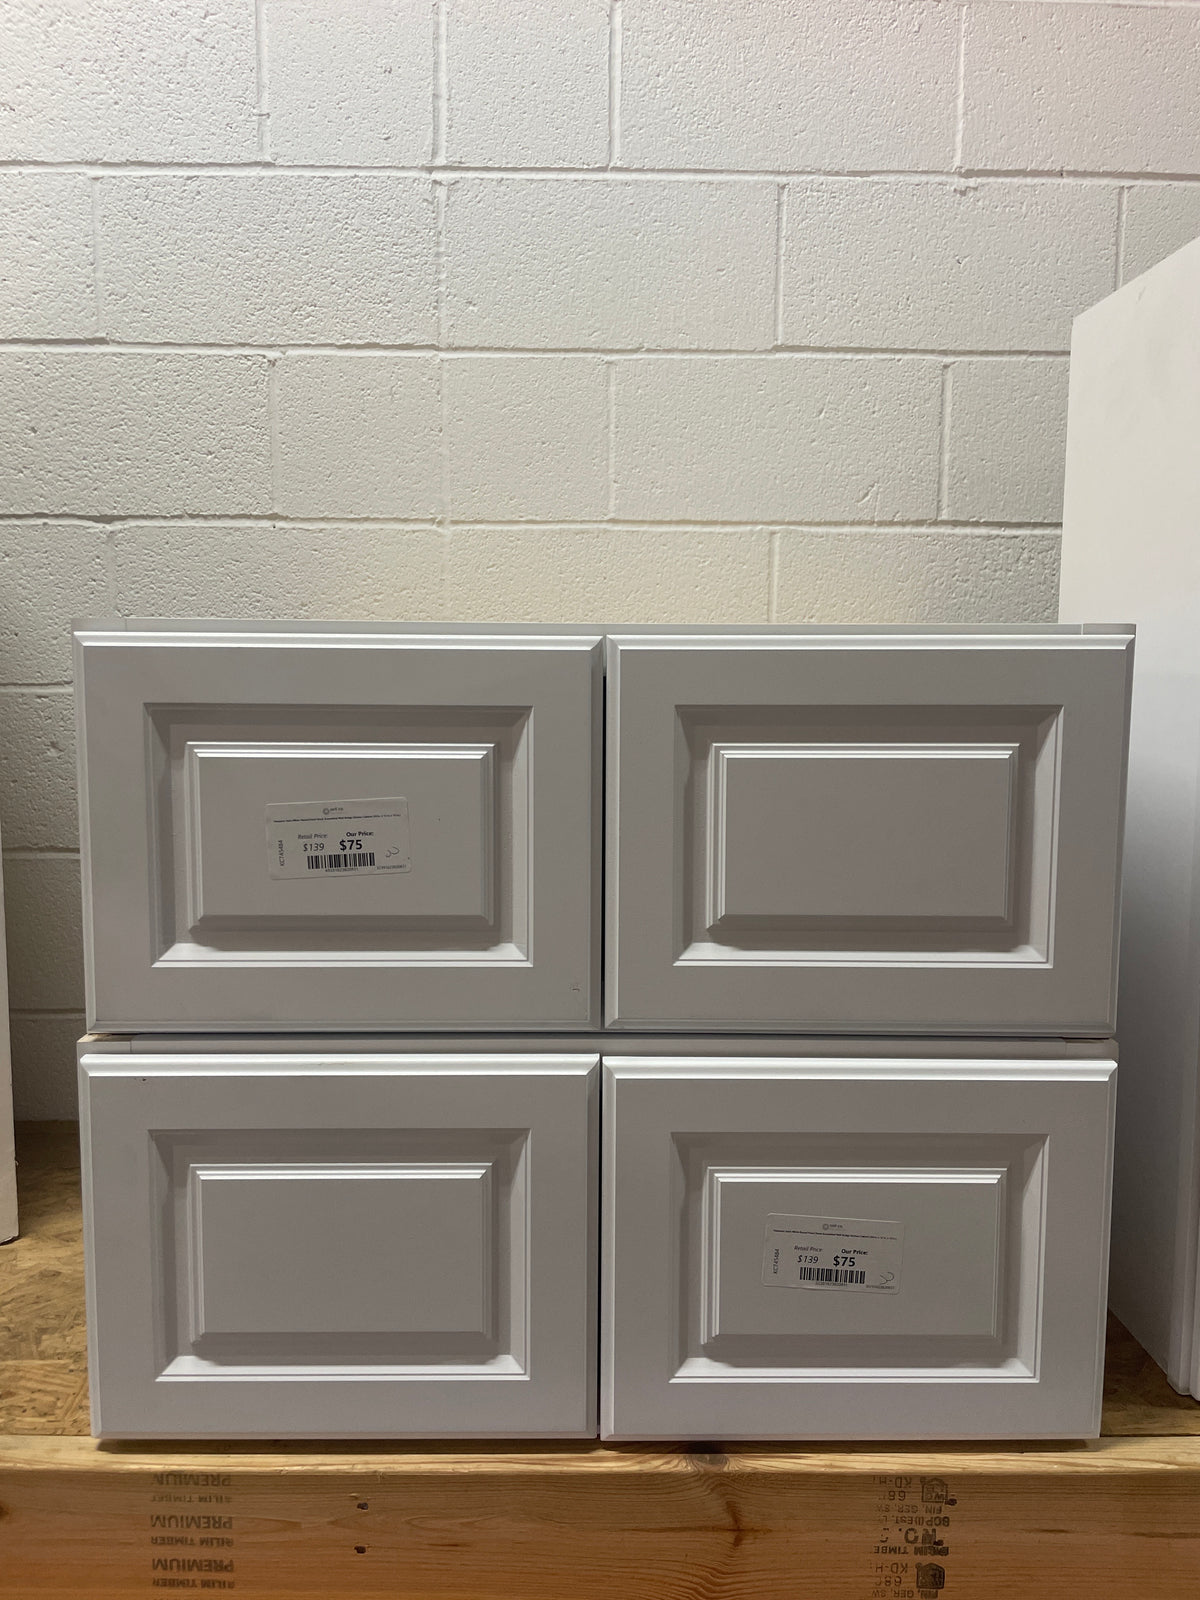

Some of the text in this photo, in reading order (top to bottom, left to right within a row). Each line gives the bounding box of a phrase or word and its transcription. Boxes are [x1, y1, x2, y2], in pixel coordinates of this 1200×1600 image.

[303, 842, 325, 852] $139
[339, 839, 363, 852] $75
[797, 1254, 819, 1264] $139
[833, 1255, 856, 1268] $75
[150, 1514, 233, 1530] PREMIUM
[150, 1536, 195, 1546] TIMBER
[152, 1558, 234, 1573] PREMIUM
[152, 1577, 197, 1589] TIMBER
